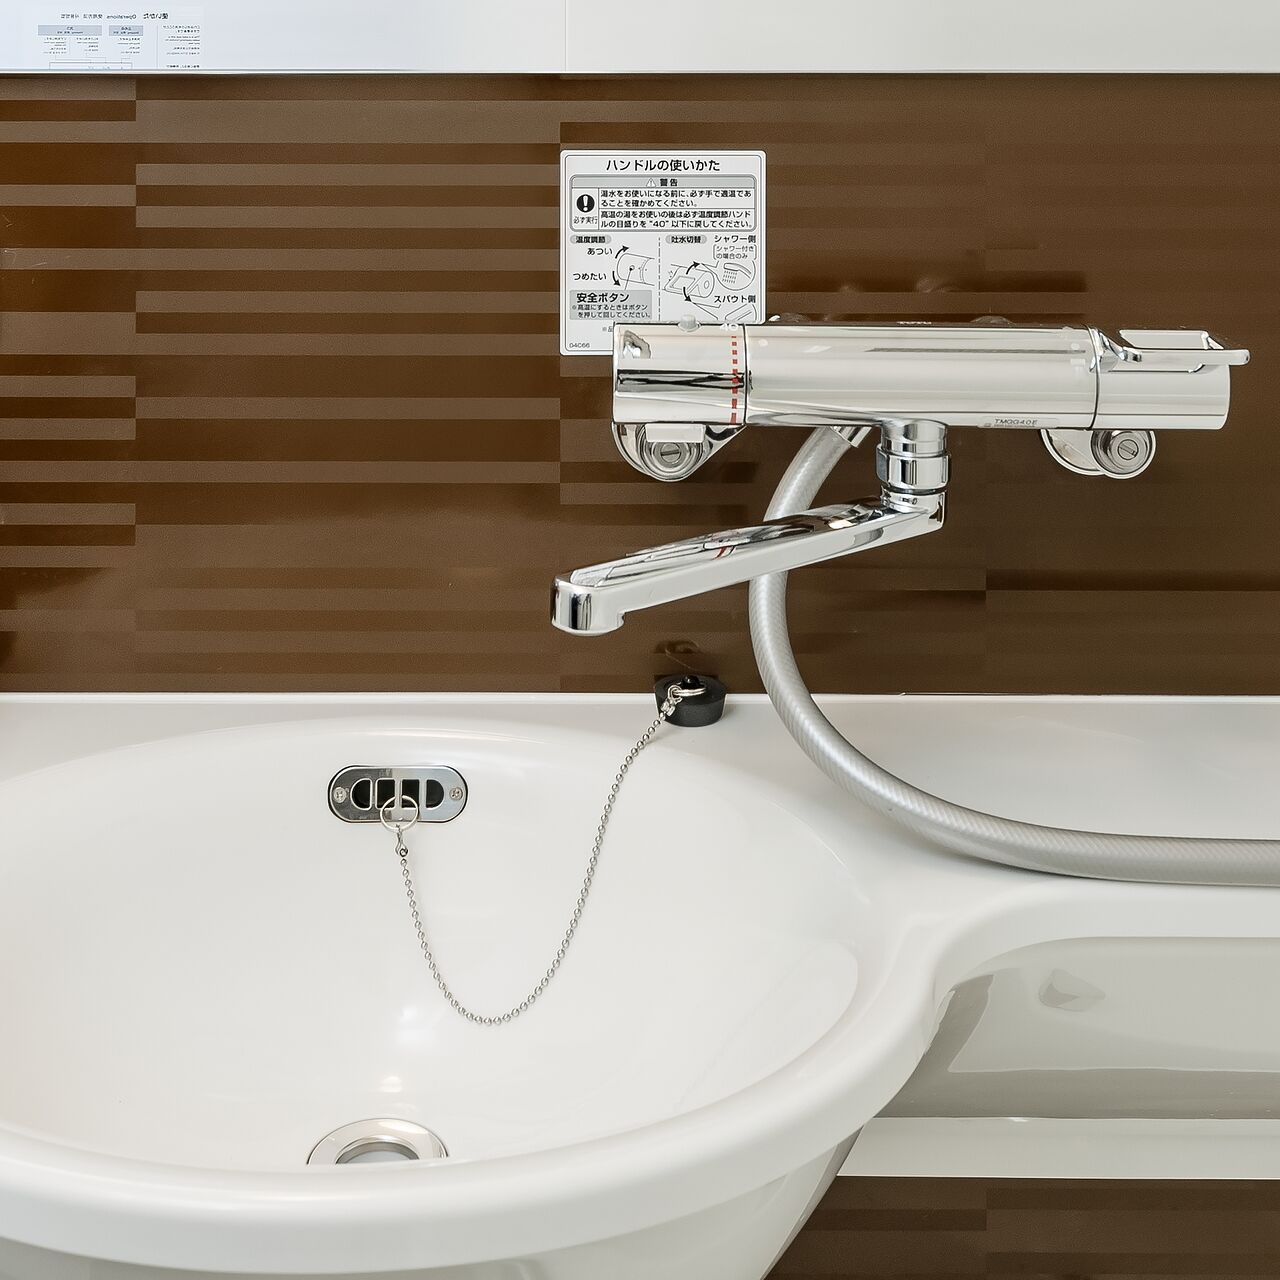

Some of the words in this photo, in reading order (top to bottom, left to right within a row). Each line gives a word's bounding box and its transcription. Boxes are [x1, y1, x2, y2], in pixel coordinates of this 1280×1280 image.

[606, 160, 720, 171] ハンドルの使いかた
[714, 235, 756, 243] シャワー側
[577, 293, 629, 303] 安全ボタン
[714, 295, 756, 303] スパウト側
